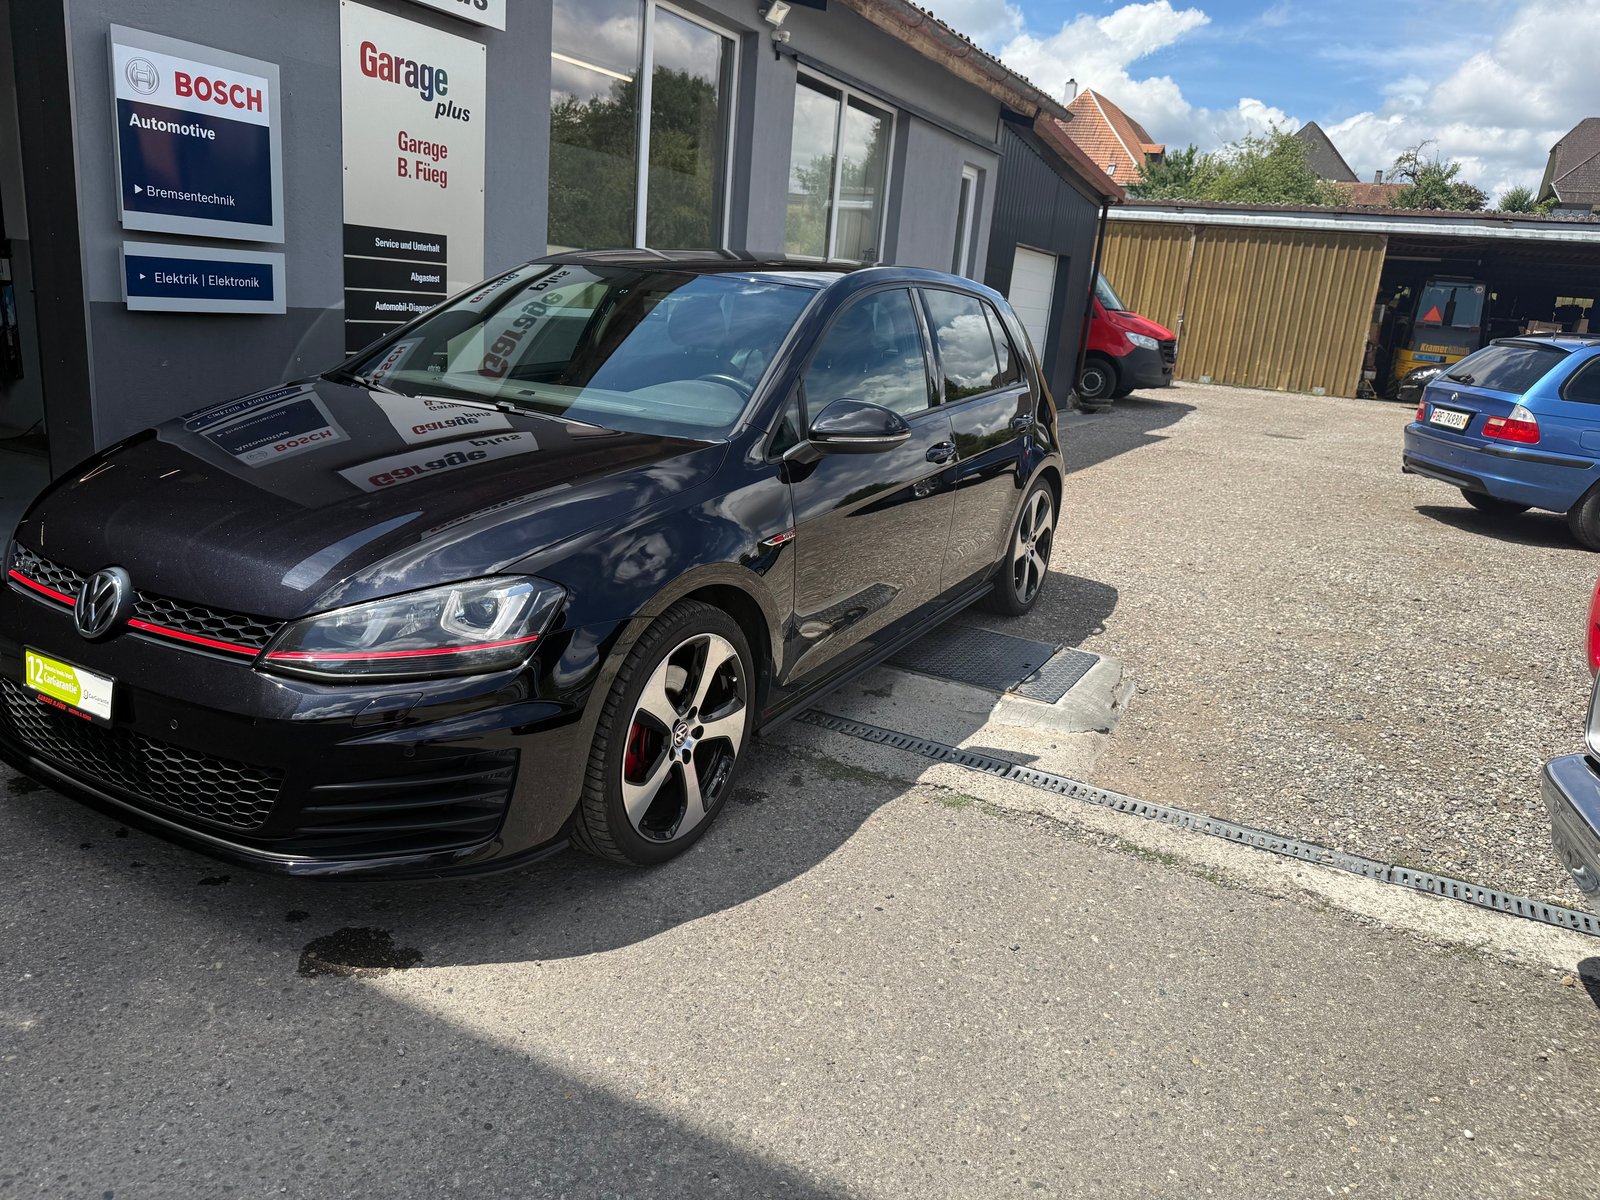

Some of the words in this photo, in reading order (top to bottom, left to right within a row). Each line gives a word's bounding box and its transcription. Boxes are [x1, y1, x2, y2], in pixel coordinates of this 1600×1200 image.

[359, 40, 448, 102] Garage
[174, 71, 263, 113] BOSCH
[434, 100, 471, 122] plus
[129, 113, 216, 140] Automotive
[398, 130, 448, 162] Garage
[397, 157, 412, 178] B.
[415, 160, 448, 189] Füeg
[146, 185, 236, 206] Bremsentechnik
[375, 237, 399, 249] Service
[400, 240, 412, 250] und
[412, 241, 440, 253] Unterhalt
[154, 272, 199, 286] Elektrik
[208, 274, 260, 288] Elektronik
[410, 272, 440, 283] Abgastest
[375, 301, 437, 313] Automobil-Diagno
[1420, 343, 1448, 353] Kramer
[27, 655, 44, 685] 12
